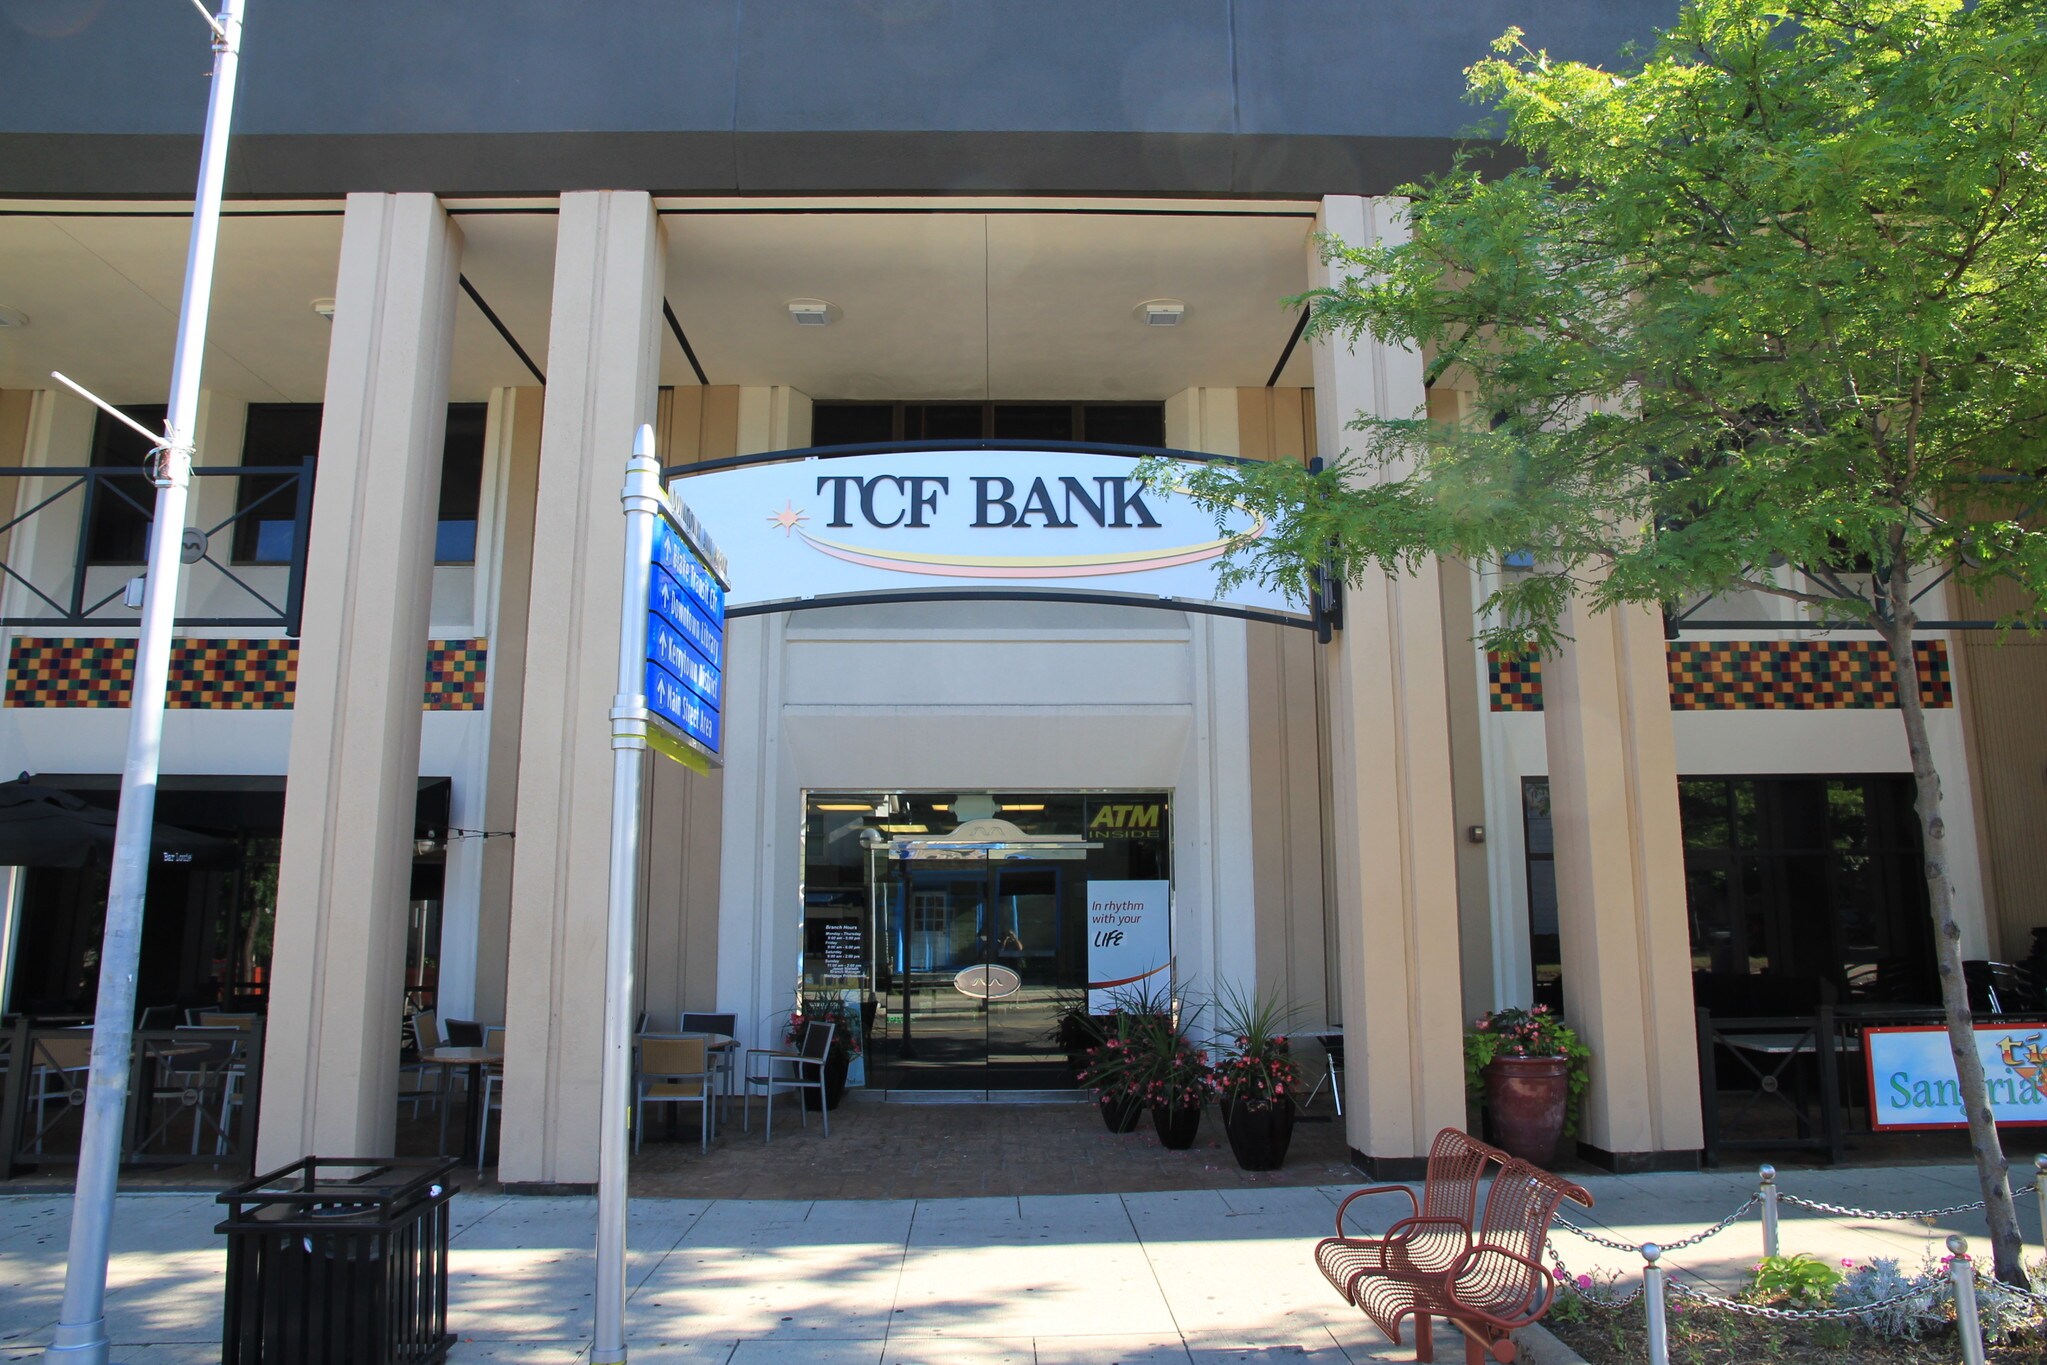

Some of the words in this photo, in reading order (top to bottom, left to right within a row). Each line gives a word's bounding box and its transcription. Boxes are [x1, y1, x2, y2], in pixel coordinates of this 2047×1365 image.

[816, 474, 949, 529] TCF
[969, 475, 1163, 529] BANK
[690, 564, 709, 606] Transit
[670, 589, 700, 641] Downtown
[700, 621, 719, 665] Library
[668, 635, 698, 685] Kerrytown
[698, 663, 718, 700] District
[667, 682, 682, 717] Main
[682, 695, 699, 730] Street
[699, 710, 713, 739] Area
[1089, 804, 1160, 829] ATM
[1089, 830, 1160, 839] INSIDE
[163, 852, 175, 862] Bar
[1092, 901, 1102, 911] In
[1104, 900, 1144, 914] rhythm
[1092, 914, 1116, 924] with
[1117, 915, 1142, 927] your
[1094, 929, 1124, 948] LIFE
[1889, 1066, 2042, 1117] Sanria
